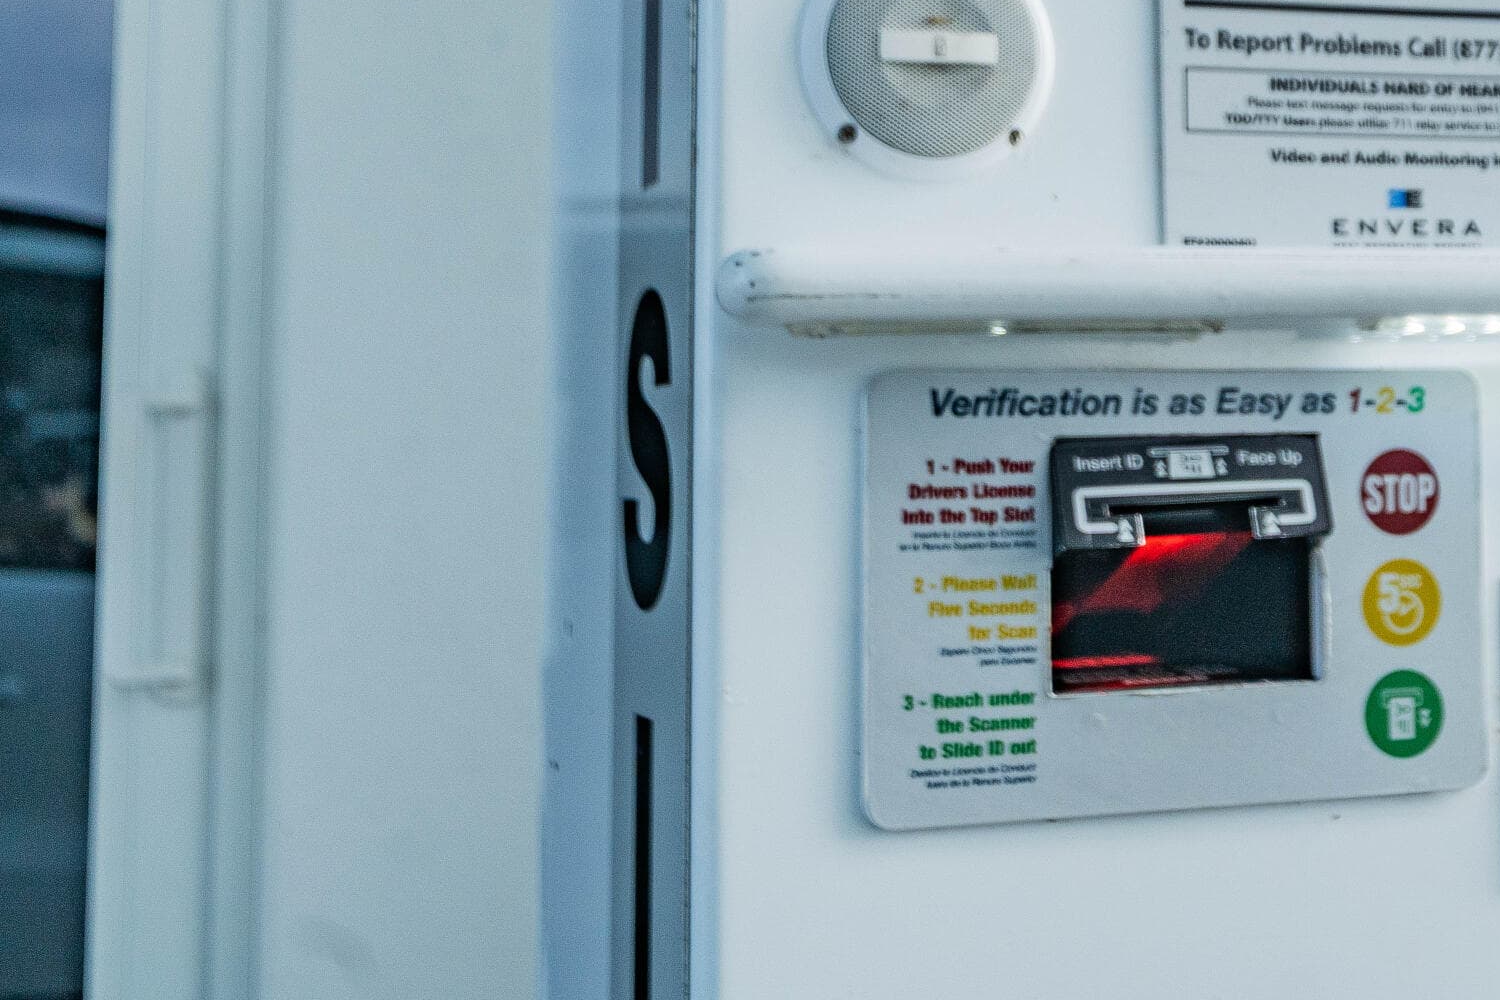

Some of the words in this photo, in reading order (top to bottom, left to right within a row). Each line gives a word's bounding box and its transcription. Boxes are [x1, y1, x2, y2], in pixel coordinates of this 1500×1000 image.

[1184, 27, 1211, 49] To
[1217, 29, 1293, 56] Report
[1301, 32, 1402, 57] Problems
[1408, 35, 1447, 58] Call
[1270, 76, 1379, 95] INDIVIDUALS
[1384, 80, 1430, 96] HARD
[1434, 82, 1454, 97] OF
[1270, 148, 1317, 164] Video
[1320, 150, 1350, 165] and
[1355, 150, 1400, 165] Audio
[1405, 152, 1490, 170] Monitoring
[1332, 217, 1482, 237] ENVERA
[928, 386, 1123, 418] Verification
[1131, 387, 1160, 415] is
[1168, 390, 1206, 415] as
[1216, 386, 1294, 421] Easy
[1301, 389, 1339, 414] as
[1348, 384, 1427, 414] 1-2-3
[926, 458, 935, 475] 1
[953, 458, 995, 474] Push
[998, 456, 1035, 474] Your
[1073, 454, 1122, 472] Insert
[1126, 453, 1144, 471] ID
[1237, 450, 1277, 466] Face
[1280, 449, 1304, 467] Up
[908, 483, 968, 499] Drivers
[972, 483, 1036, 499] License
[1363, 472, 1437, 515] STOP
[902, 508, 935, 525] Into
[939, 507, 966, 524] the
[970, 506, 999, 526] Top
[1003, 505, 1036, 523] Slot
[914, 576, 924, 594] 2
[942, 574, 997, 592] Please
[1001, 572, 1037, 591] Wait
[928, 600, 962, 617] Five
[968, 599, 1037, 616] Seconds
[968, 624, 991, 641] for
[997, 623, 1037, 639] Scan
[904, 694, 914, 711] 3
[932, 691, 983, 709] Reach
[988, 689, 1036, 706] under
[936, 718, 964, 734] the
[969, 716, 1036, 733] Scanner
[919, 744, 937, 760] to
[942, 741, 983, 759] Slide
[988, 739, 1004, 756] ID
[1010, 738, 1037, 756] out
